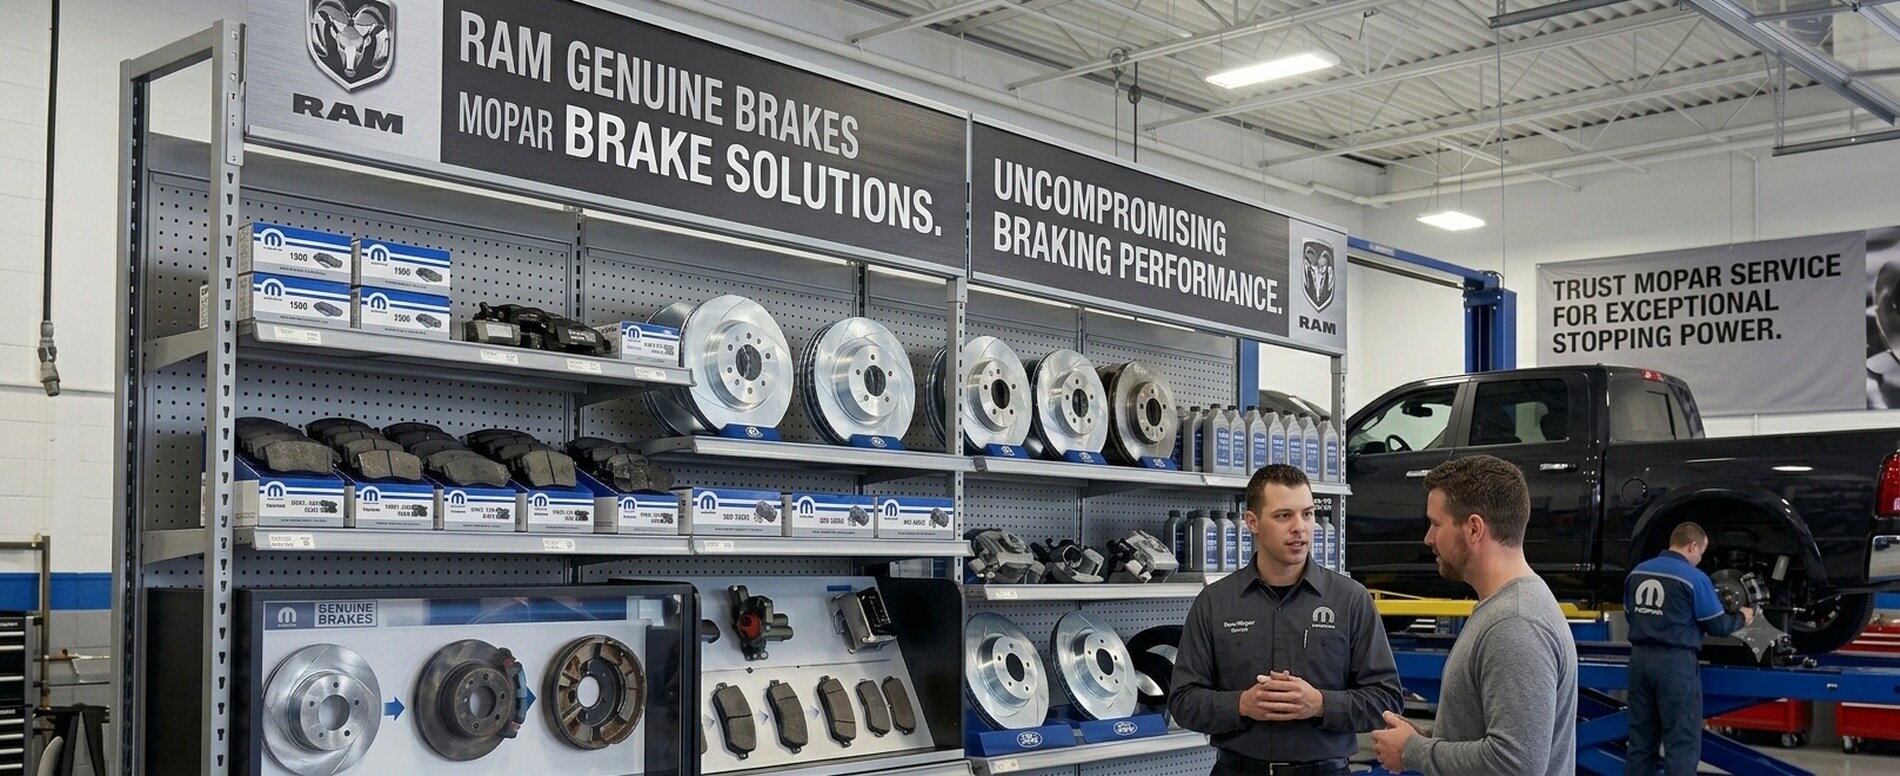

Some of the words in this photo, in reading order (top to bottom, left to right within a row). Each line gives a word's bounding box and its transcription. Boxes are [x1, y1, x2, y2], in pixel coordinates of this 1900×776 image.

[460, 10, 552, 83] RAM
[567, 40, 724, 126] GENUINE
[736, 85, 860, 160] BRAKES
[293, 93, 404, 135] RAM
[459, 91, 554, 152] MOPAR
[565, 104, 713, 186] BRAKE
[726, 143, 943, 236] SOLUTIONS.
[994, 158, 1227, 256] UNCOMPROMISING
[994, 211, 1112, 277] BRAKING
[1119, 241, 1283, 315] PERFORMANCE.
[1552, 275, 1626, 301] TRUST
[1634, 265, 1722, 294] MOPAR
[1730, 253, 1842, 286] SERVICE
[1299, 316, 1336, 335] RAM
[1553, 303, 1598, 328] FOR
[1606, 288, 1780, 324] EXCEPTIONAL
[1552, 324, 1672, 354] STOPPING
[1680, 317, 1783, 346] POWER.
[319, 614, 373, 625] BRAKES
